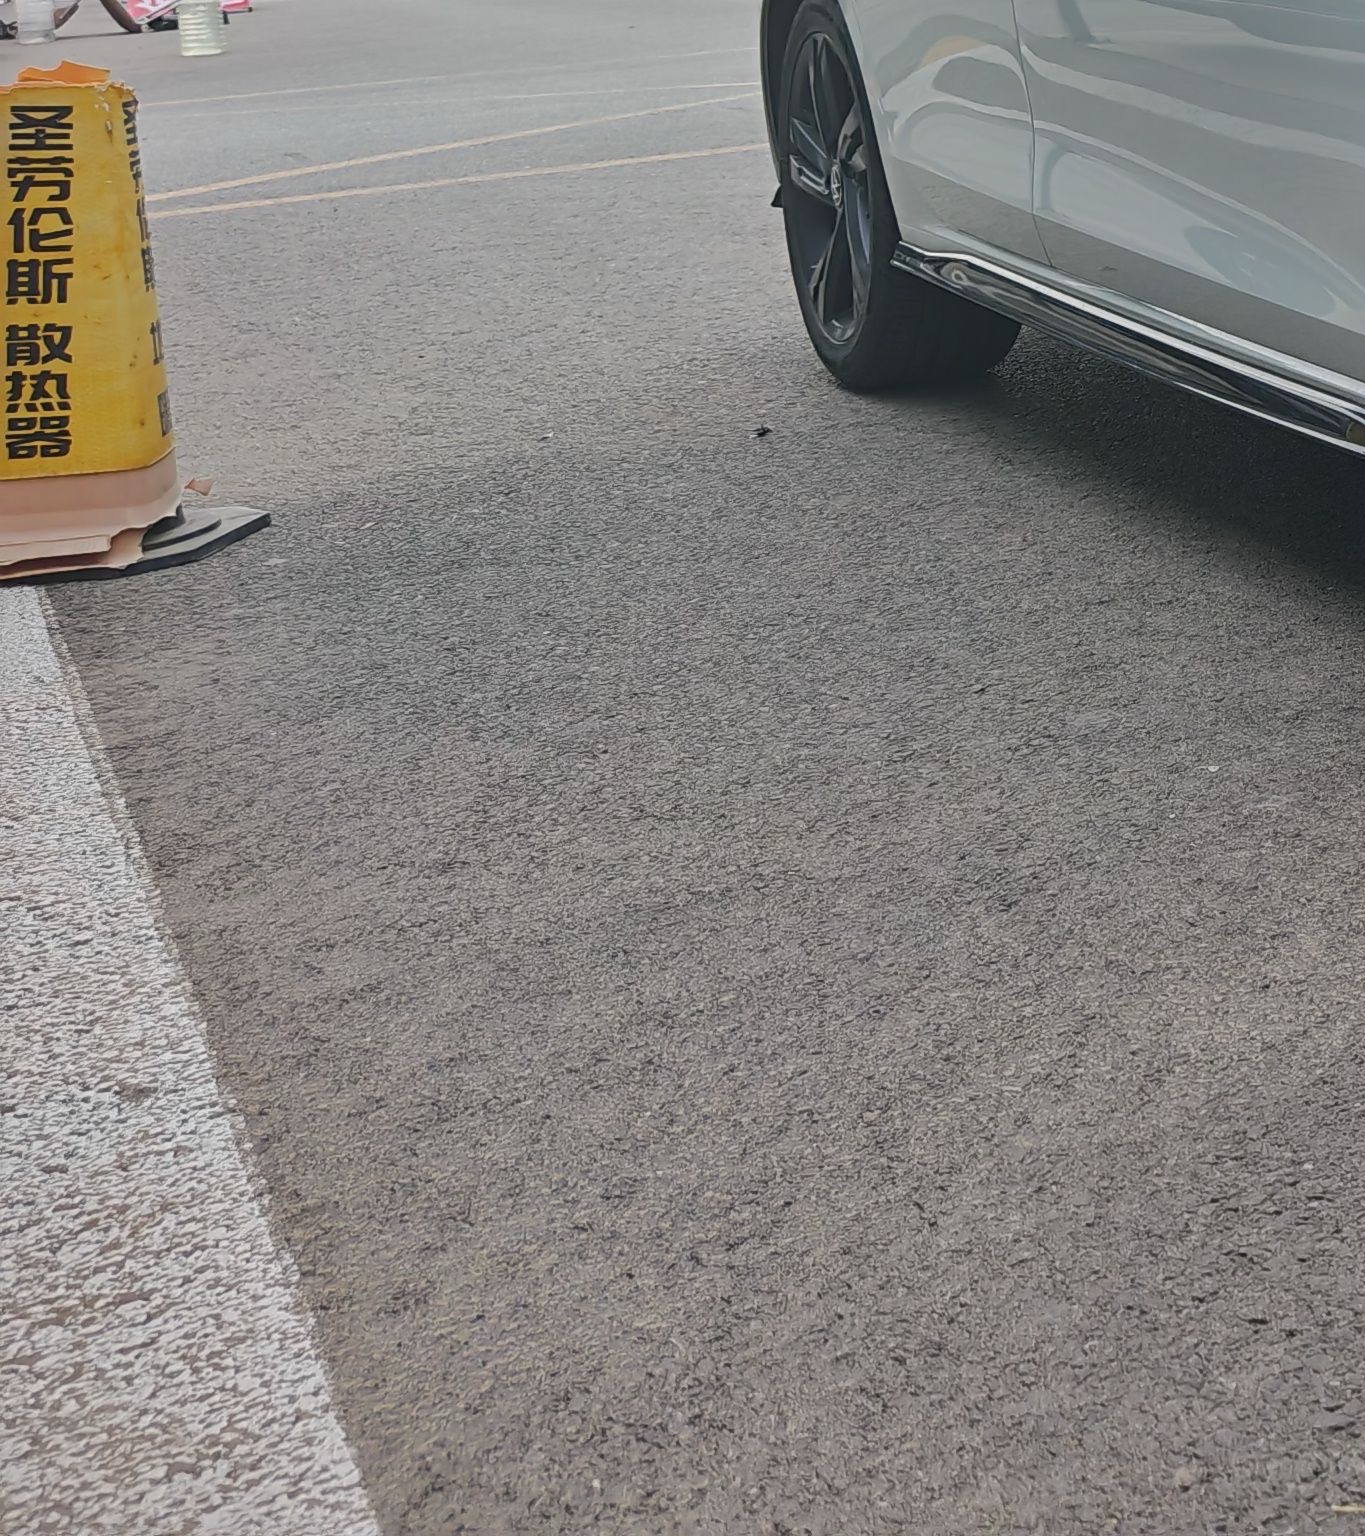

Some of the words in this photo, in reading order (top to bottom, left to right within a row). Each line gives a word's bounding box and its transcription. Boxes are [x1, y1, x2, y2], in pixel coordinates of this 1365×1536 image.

[6, 104, 75, 305] 圣劳伦斯
[5, 322, 74, 460] 散热器
